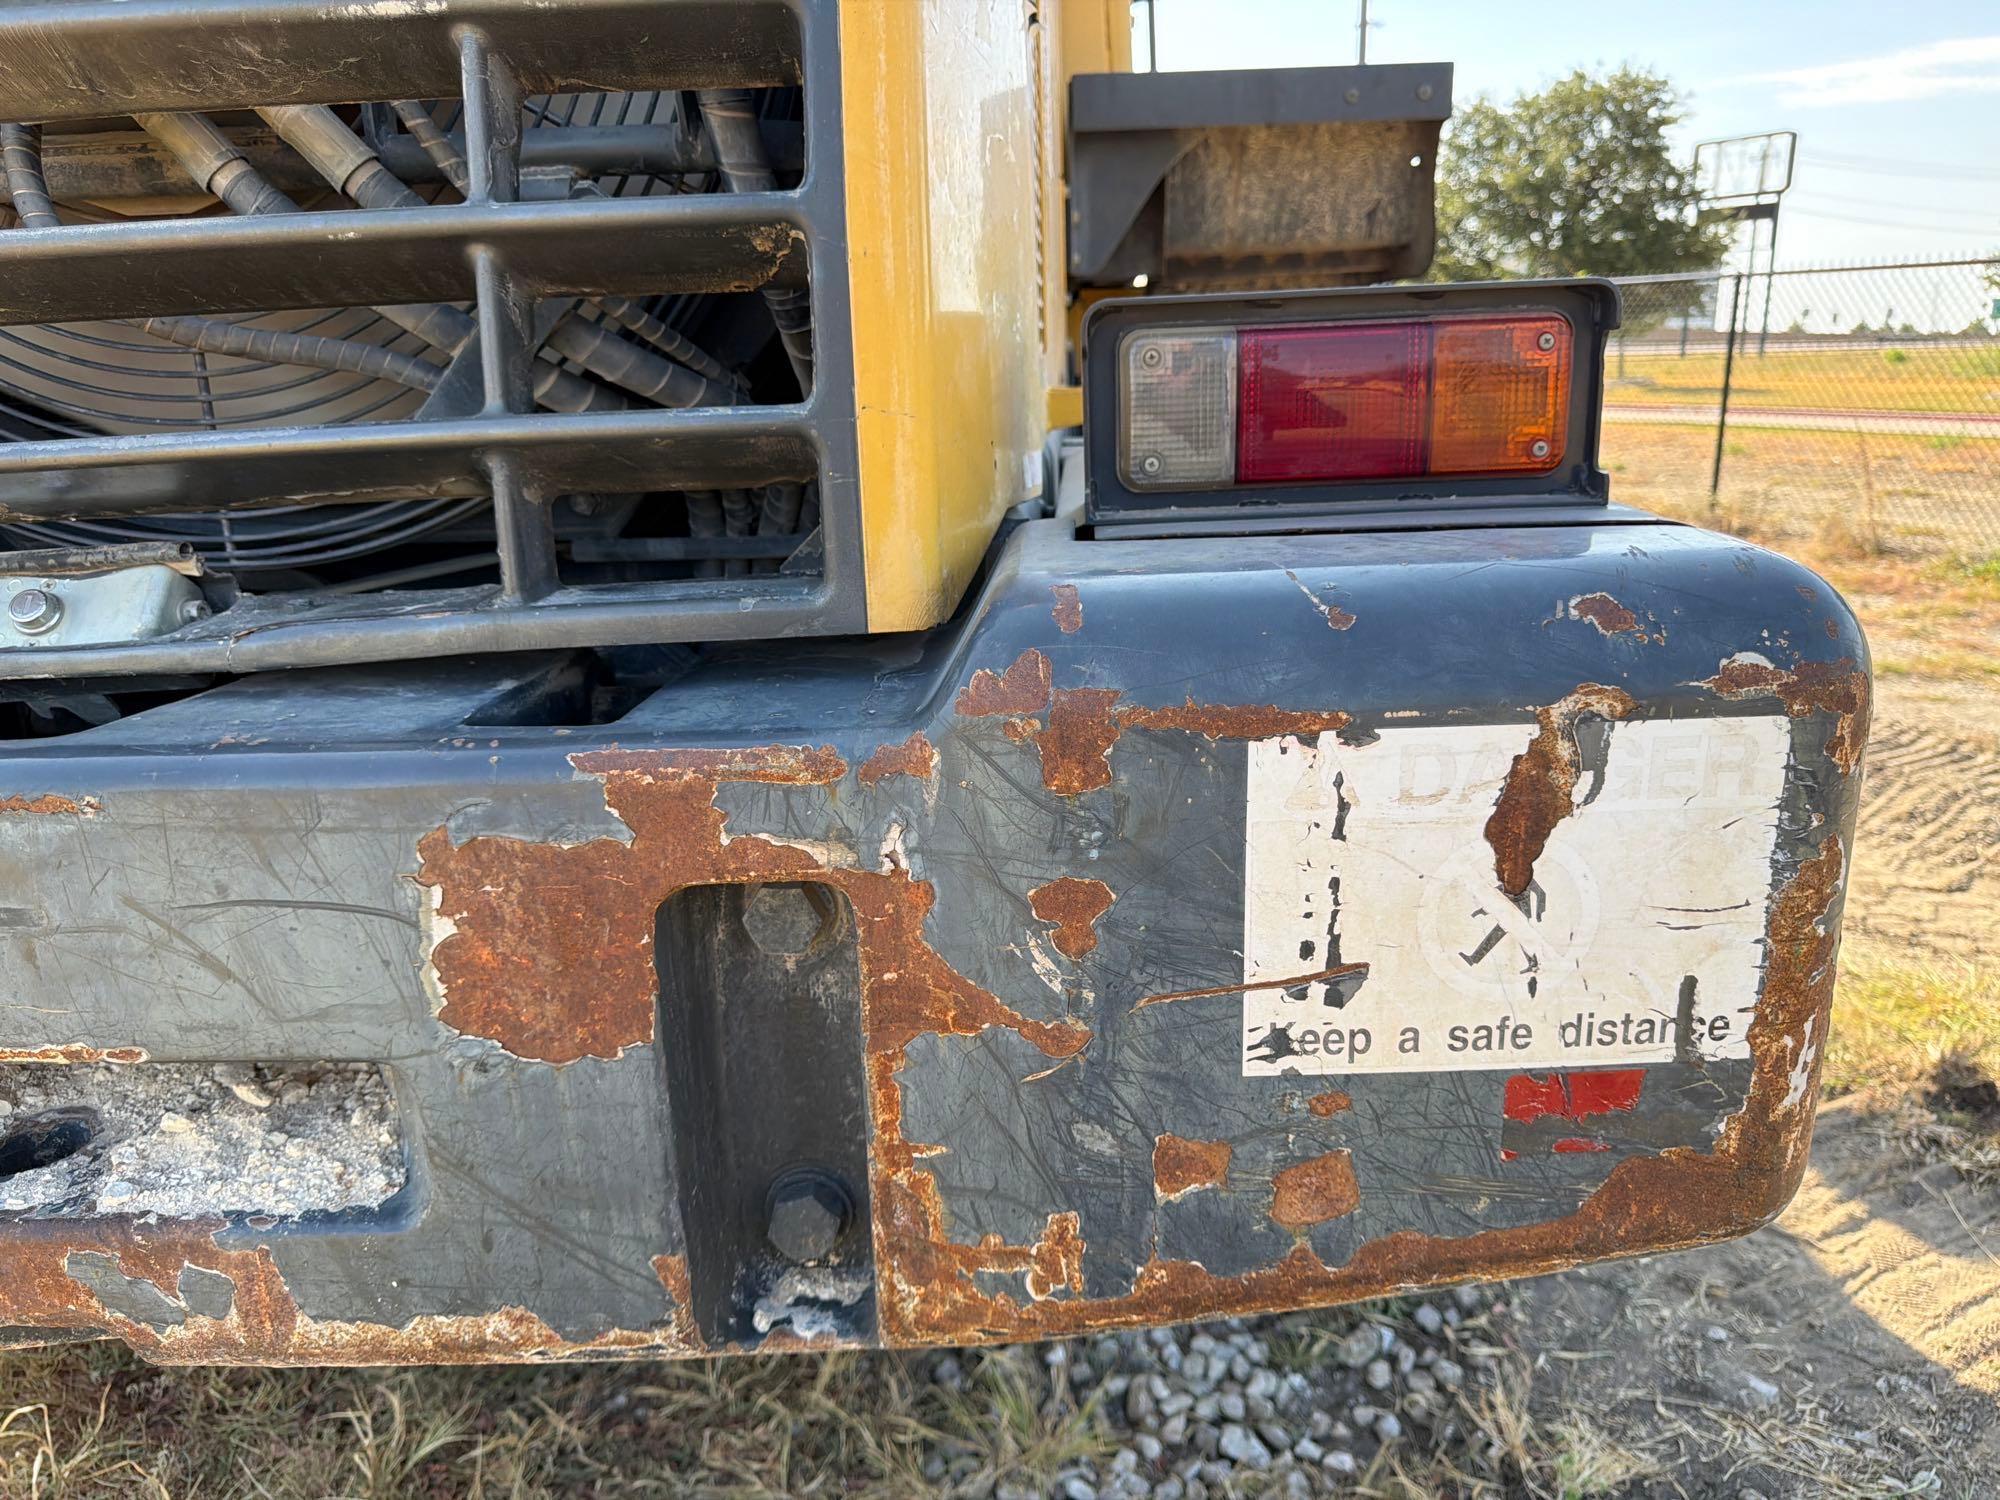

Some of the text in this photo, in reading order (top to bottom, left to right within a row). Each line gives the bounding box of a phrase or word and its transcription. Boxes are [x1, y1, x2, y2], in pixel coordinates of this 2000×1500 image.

[1399, 733, 1761, 804] DAGER
[1398, 1026, 1420, 1053] a
[1447, 1015, 1533, 1052] safe
